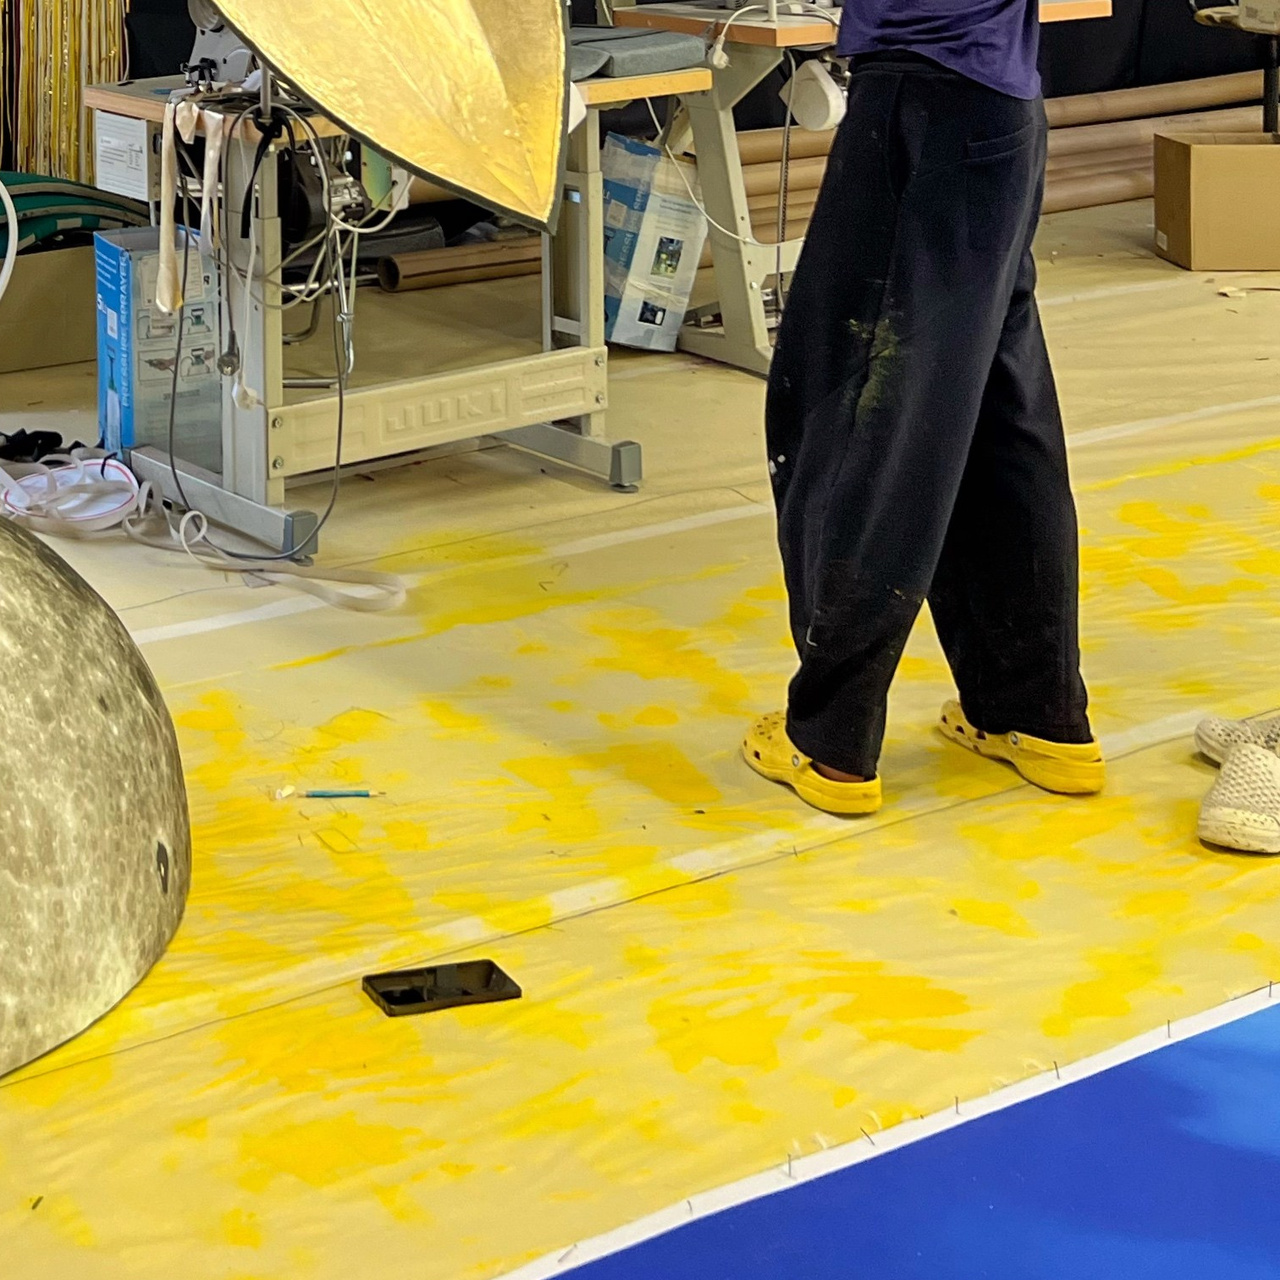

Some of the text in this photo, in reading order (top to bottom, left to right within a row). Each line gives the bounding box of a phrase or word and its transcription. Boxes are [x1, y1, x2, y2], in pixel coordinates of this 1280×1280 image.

[119, 250, 130, 408] PRESSURE SPRAYER
[386, 388, 503, 433] JUKI
